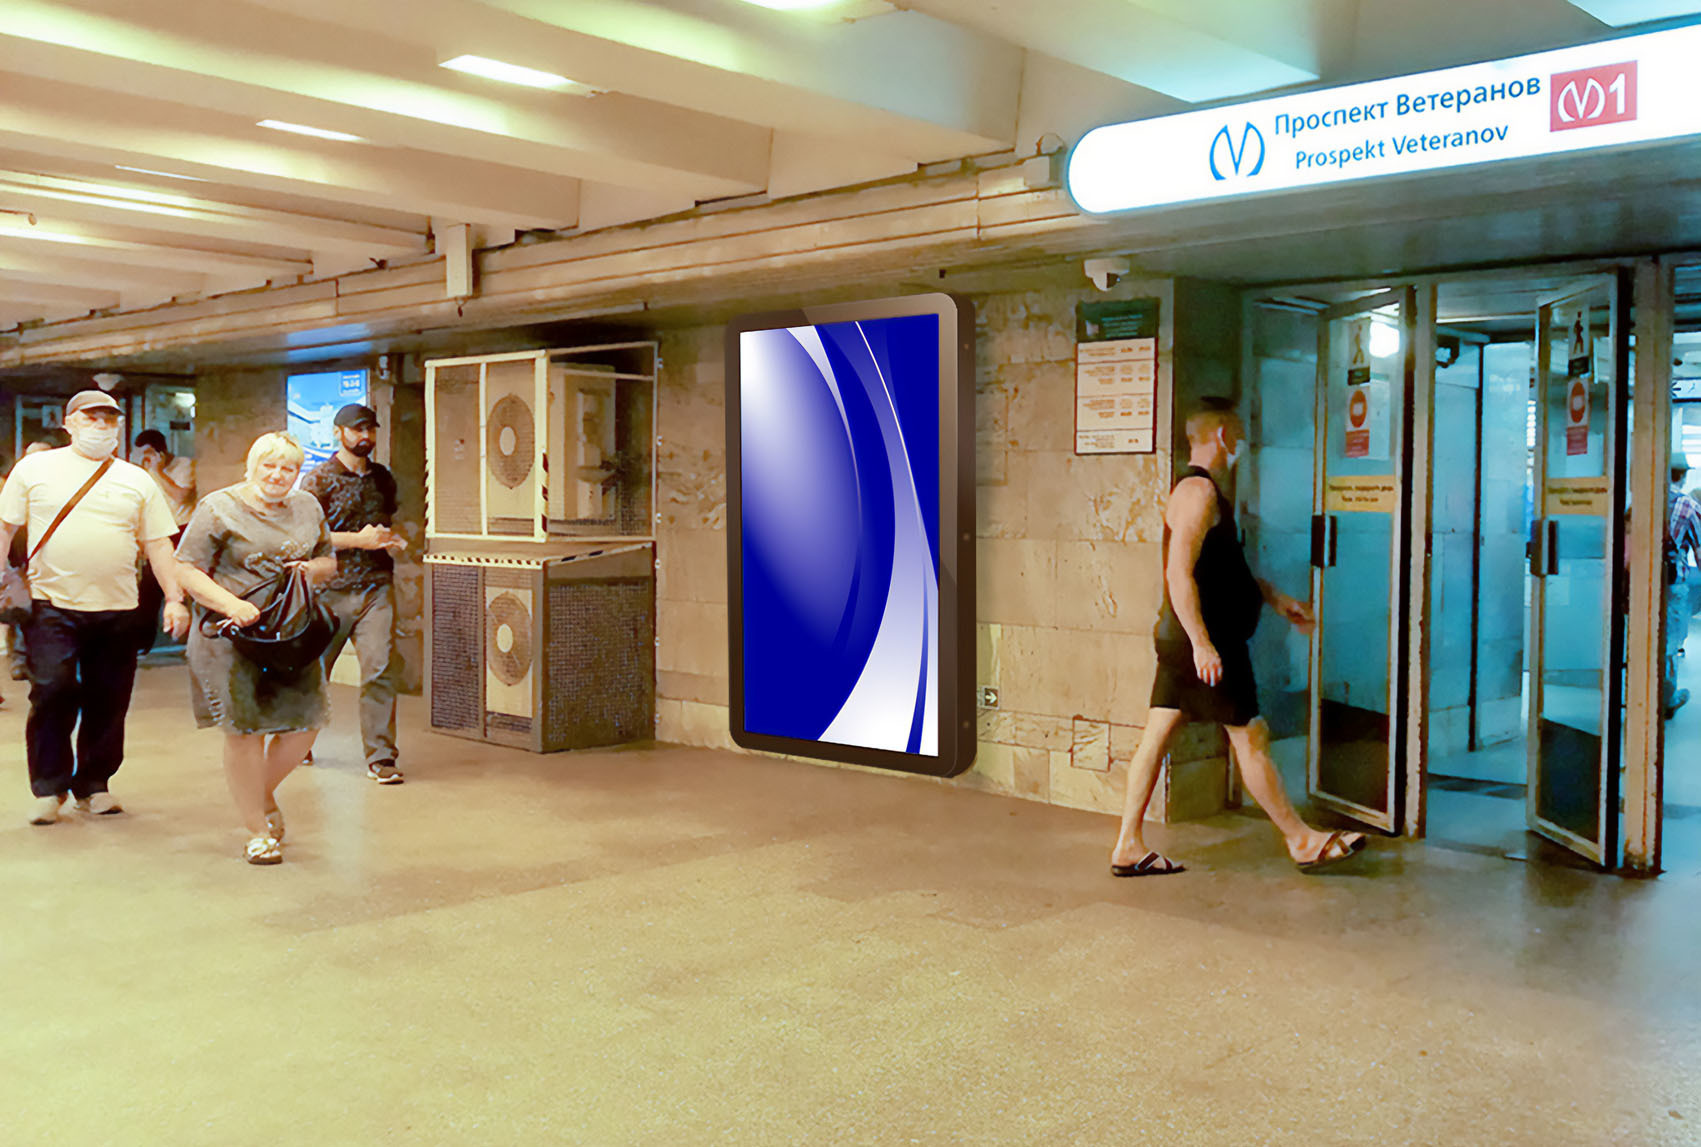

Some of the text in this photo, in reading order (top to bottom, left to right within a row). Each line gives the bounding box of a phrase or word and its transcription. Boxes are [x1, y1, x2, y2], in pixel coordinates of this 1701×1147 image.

[1275, 77, 1542, 138] Проспект Ветеранов
[1295, 125, 1509, 169] Prospekt Veteranov
